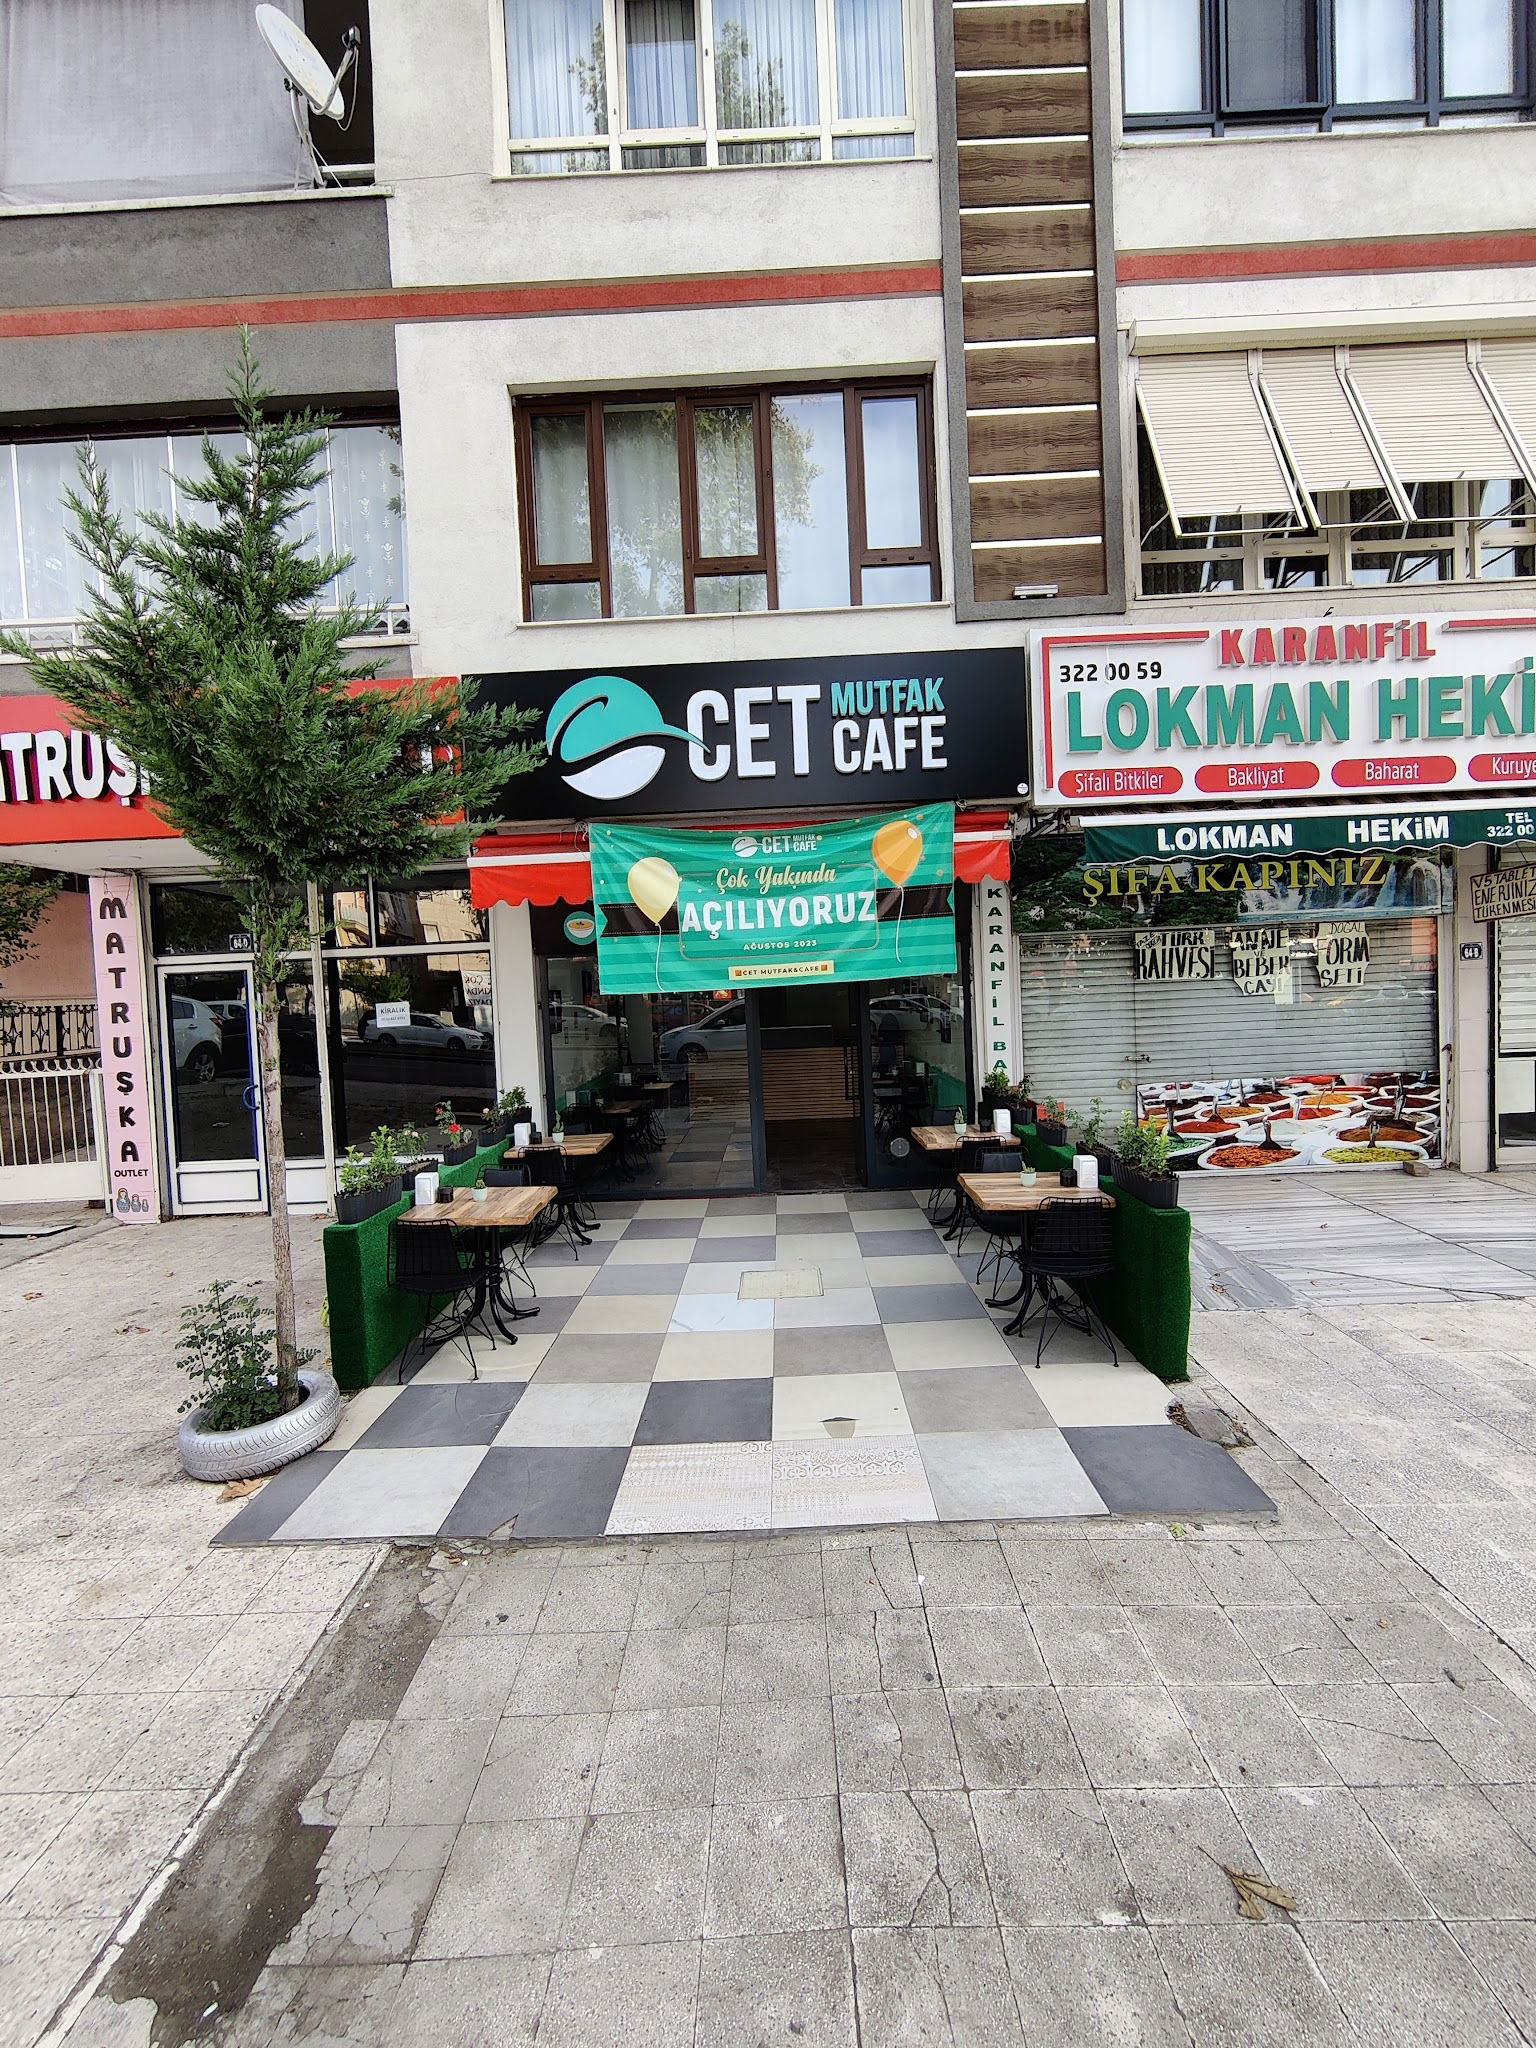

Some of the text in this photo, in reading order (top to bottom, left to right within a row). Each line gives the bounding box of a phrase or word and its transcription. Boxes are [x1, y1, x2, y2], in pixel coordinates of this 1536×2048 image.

[1218, 619, 1436, 667] KARANFİL
[1060, 664, 1098, 682] 322
[1137, 661, 1162, 679] 59
[831, 677, 945, 716] MUTFAK
[1066, 680, 1350, 752] LOKMAN
[687, 685, 821, 781] CET
[833, 715, 948, 774] CAFE
[1228, 767, 1284, 789] Bakliyat
[1365, 761, 1419, 780] Baharat
[1075, 771, 1164, 793] Şifalı Bitkiler
[1505, 812, 1533, 823] TEL
[1157, 816, 1450, 851] LOKMAN HEKİM
[1487, 826, 1514, 837] 322
[761, 835, 791, 854] CET
[793, 840, 817, 852] CAFE
[716, 863, 837, 895] Çok Yakında
[1196, 855, 1388, 893] KAPINIZ
[682, 891, 877, 940] AÇILIYORUZ
[743, 940, 817, 951] AĞUSTOS 2023
[743, 965, 820, 976] CET MUTFAK&CAFE
[99, 897, 140, 1163] MATRUŞKA
[114, 1168, 149, 1178] OUTLET
